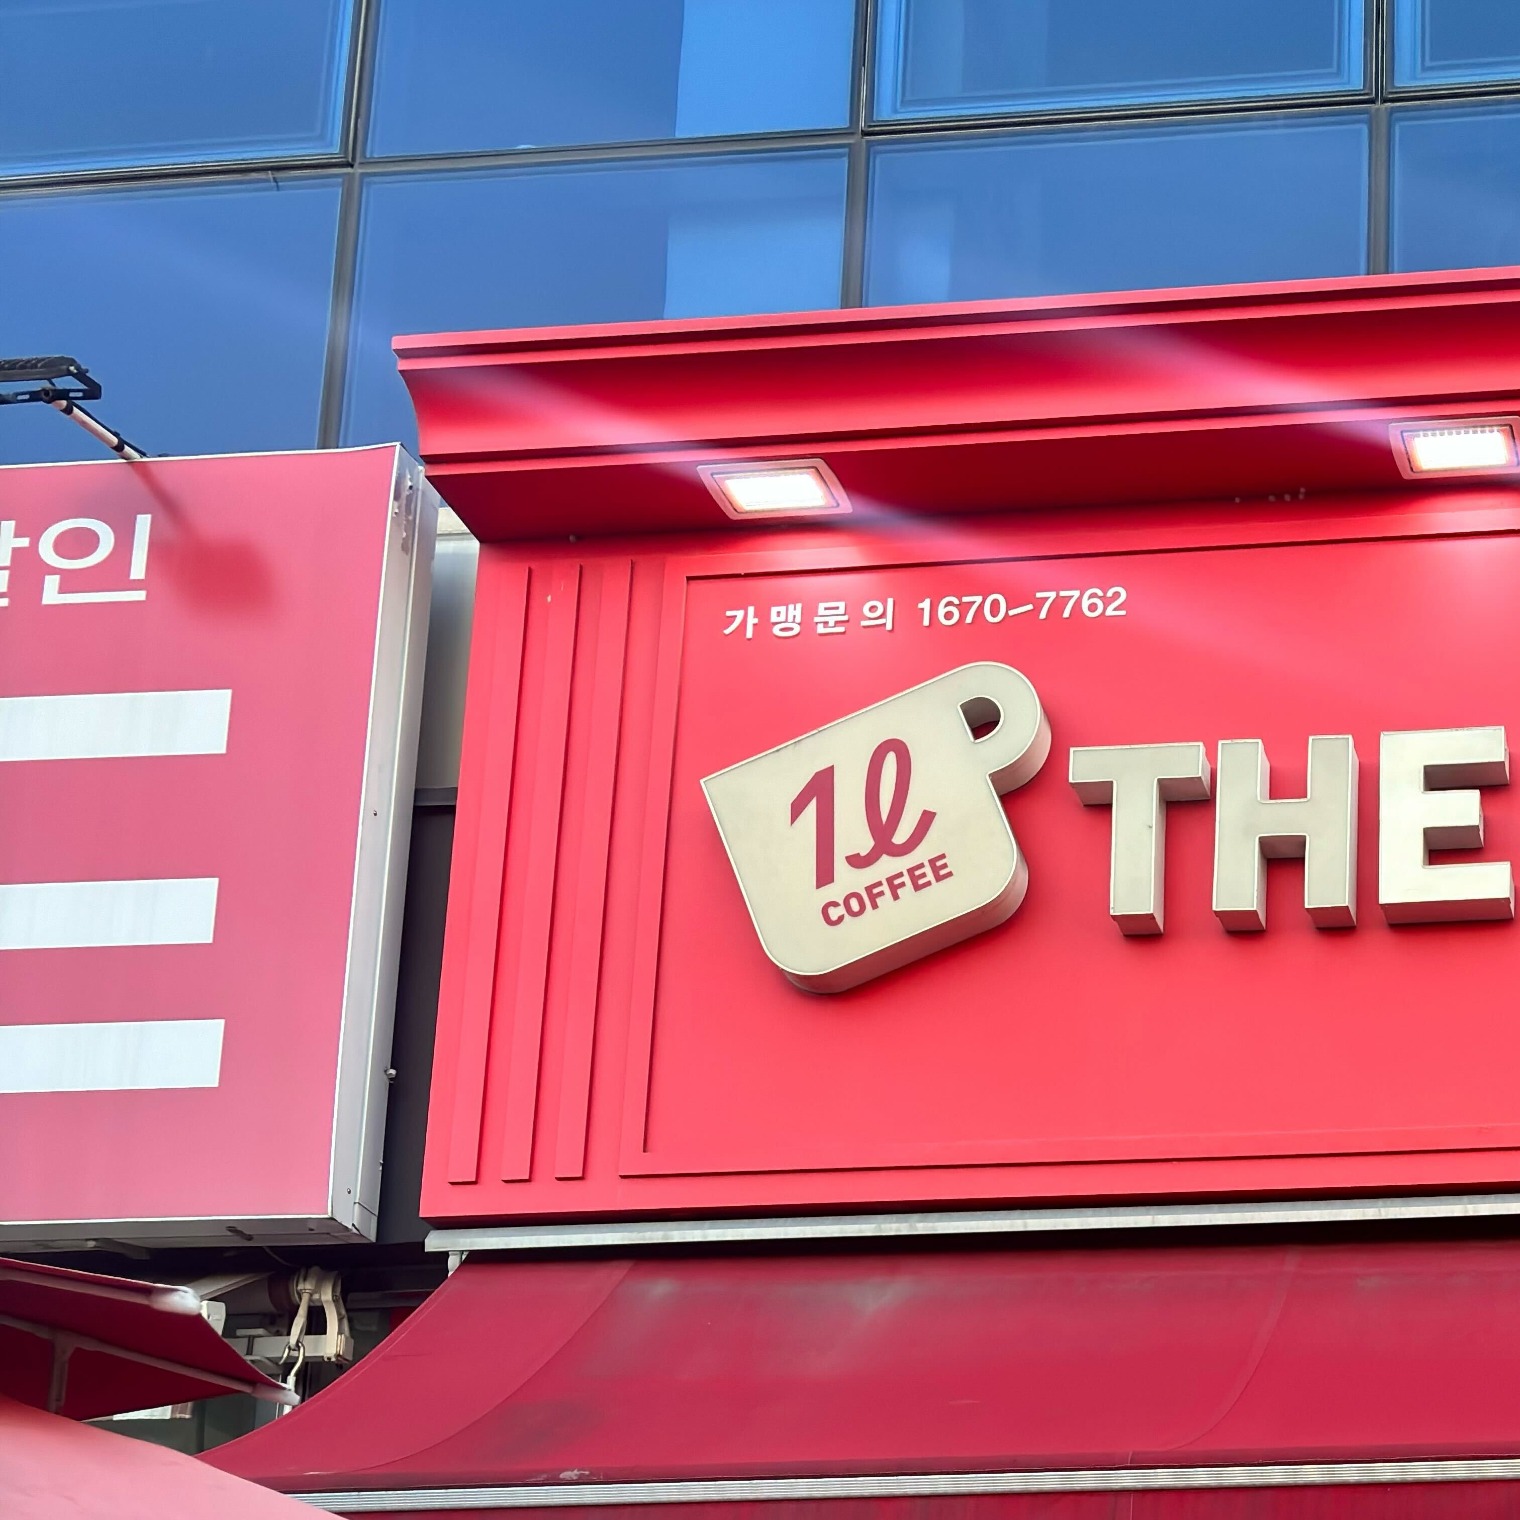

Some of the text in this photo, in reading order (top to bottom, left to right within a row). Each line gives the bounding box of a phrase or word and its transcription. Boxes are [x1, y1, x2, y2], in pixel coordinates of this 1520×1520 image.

[918, 586, 1129, 628] 1670-7762
[1069, 725, 1514, 936] THE
[820, 852, 954, 928] COFFEE
